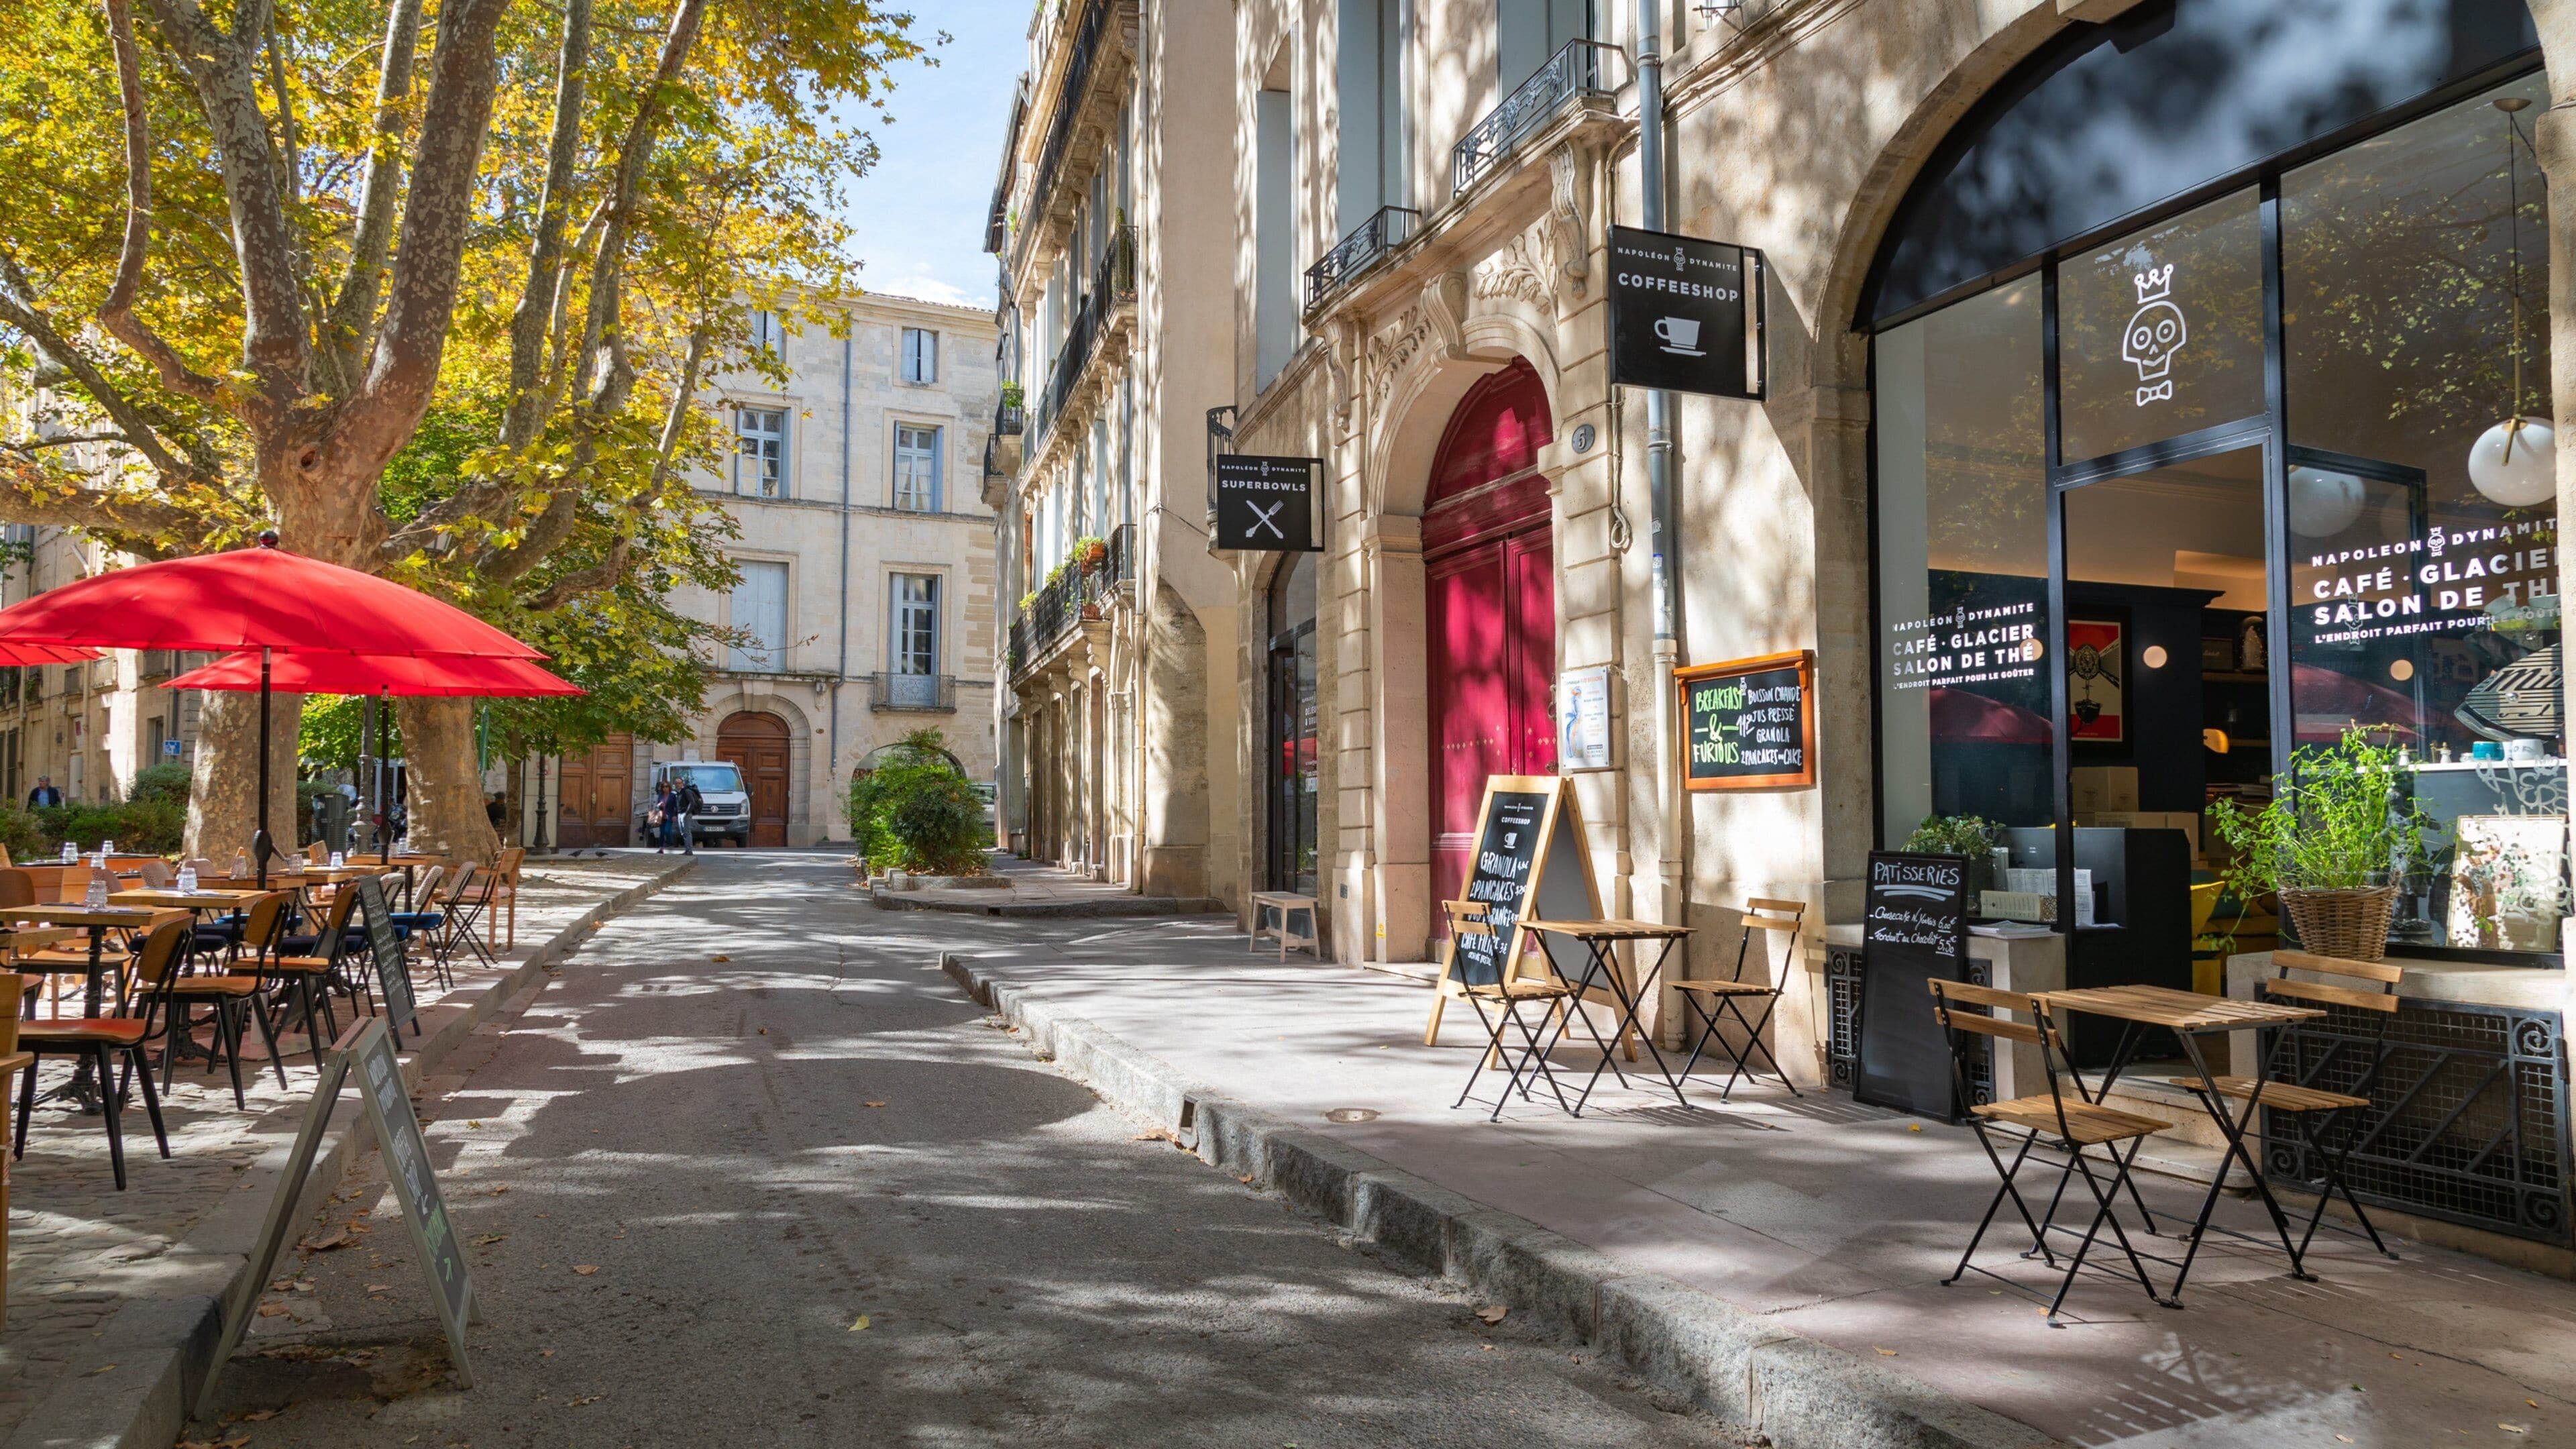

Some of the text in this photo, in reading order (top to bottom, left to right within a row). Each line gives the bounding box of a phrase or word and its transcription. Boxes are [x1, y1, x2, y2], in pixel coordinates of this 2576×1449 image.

[1617, 247, 1737, 272] NAPOLÉON DYNAMITE
[1618, 272, 1738, 302] COFFEESHOP
[1222, 480, 1306, 492] SUPERBOWLS
[2312, 539, 2422, 568] NAPOLEON
[2314, 566, 2393, 599] CAFÉ
[1892, 602, 2034, 632] NAPOLEON DYNAMITE
[2314, 594, 2421, 625] SALON
[2439, 586, 2483, 611] DE
[1893, 624, 2034, 655] CAFÉ GLACIER
[2314, 627, 2383, 645] L'ENDROIT
[2385, 621, 2443, 637] PARFAIT
[2447, 616, 2486, 629] POUR
[1893, 641, 2034, 676] SALON DE THÉ
[1894, 668, 2034, 690] L'ENDROIT PARFAIT POUR LE GOÛTER
[1695, 686, 1744, 712] BREAKFAST
[1748, 688, 1774, 705] BOISSON
[1752, 709, 1766, 722] JUS
[1756, 727, 1790, 743] GRANOLA
[1501, 816, 1531, 825] COFFEESHOP
[1481, 851, 1517, 879] GRANOLA
[1874, 927, 1904, 943] Fondant
[1911, 931, 1942, 945] Chocolat
